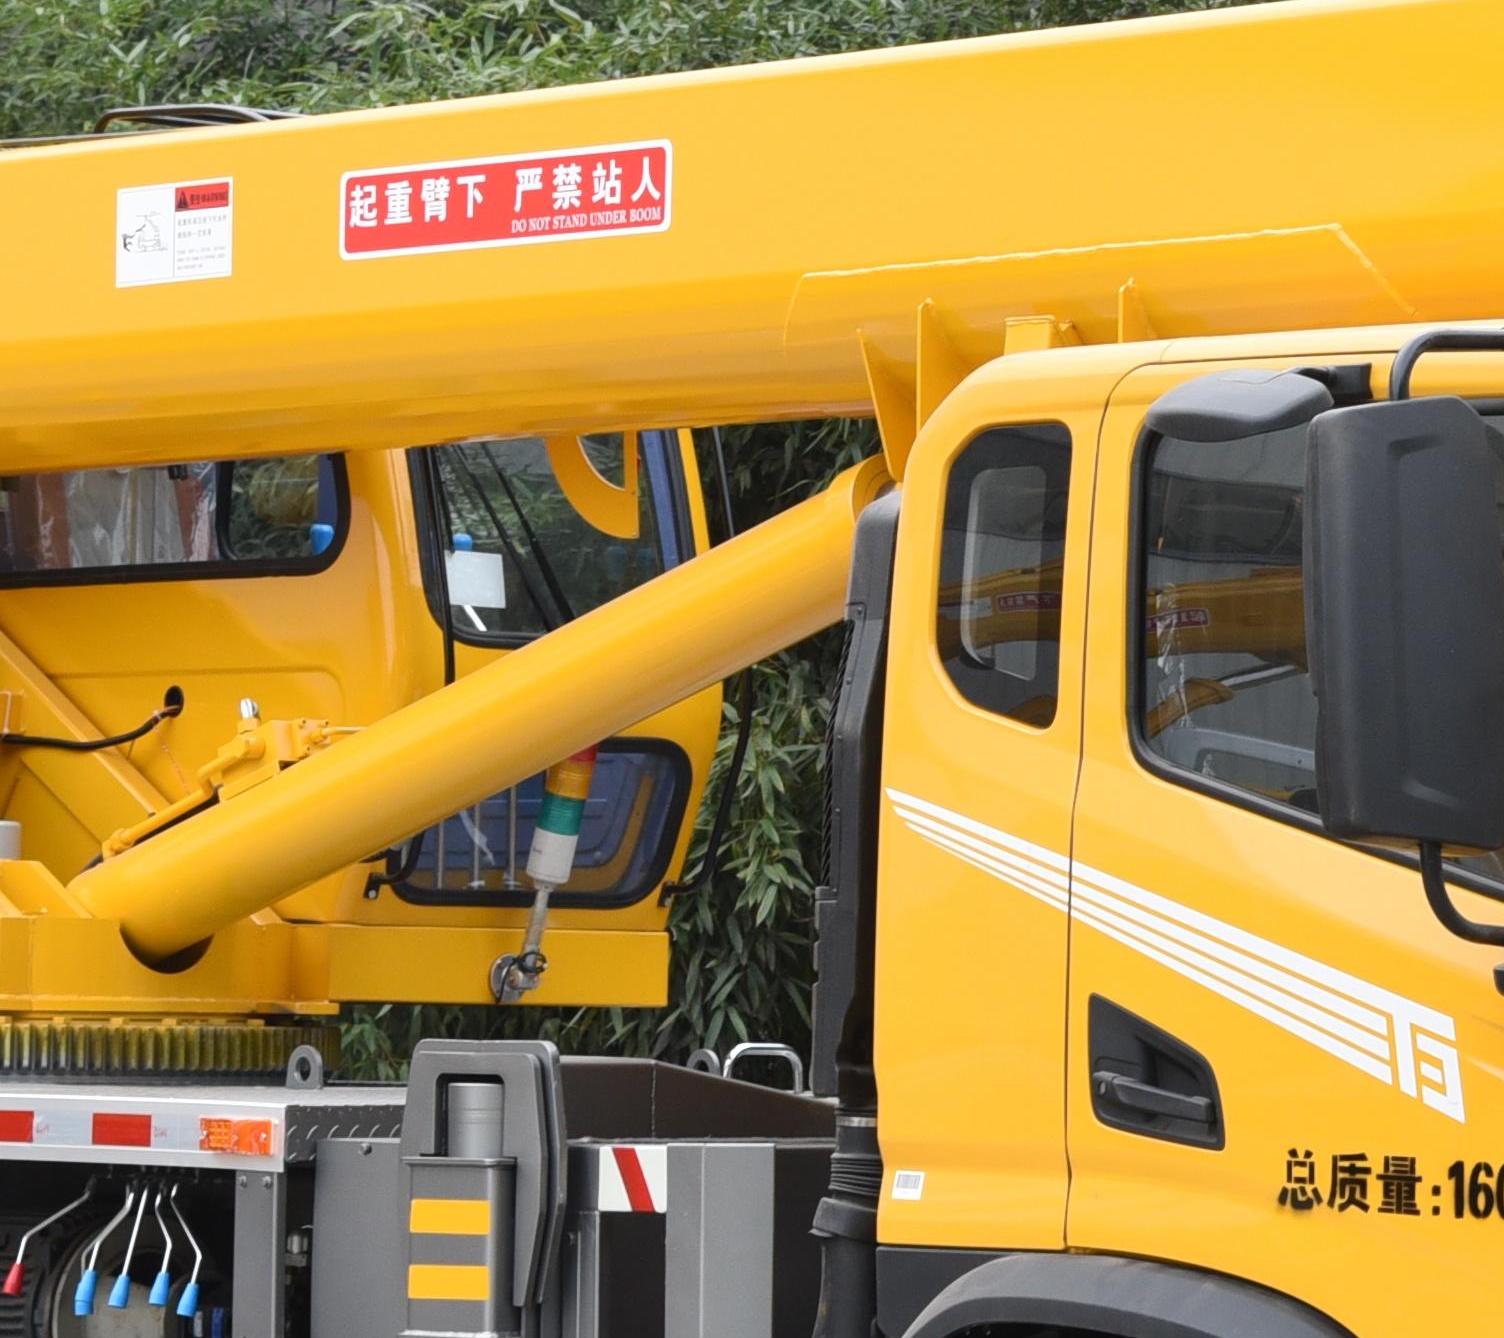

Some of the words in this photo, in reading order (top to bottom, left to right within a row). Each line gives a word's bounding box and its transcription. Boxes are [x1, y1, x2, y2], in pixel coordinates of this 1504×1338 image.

[348, 173, 487, 228] 起重臂下
[513, 155, 662, 213] 严禁站人
[511, 219, 527, 234] DO
[527, 216, 550, 232] NOT
[552, 213, 588, 230] STAND
[589, 209, 627, 227] UNDER
[629, 206, 662, 223] BOOM
